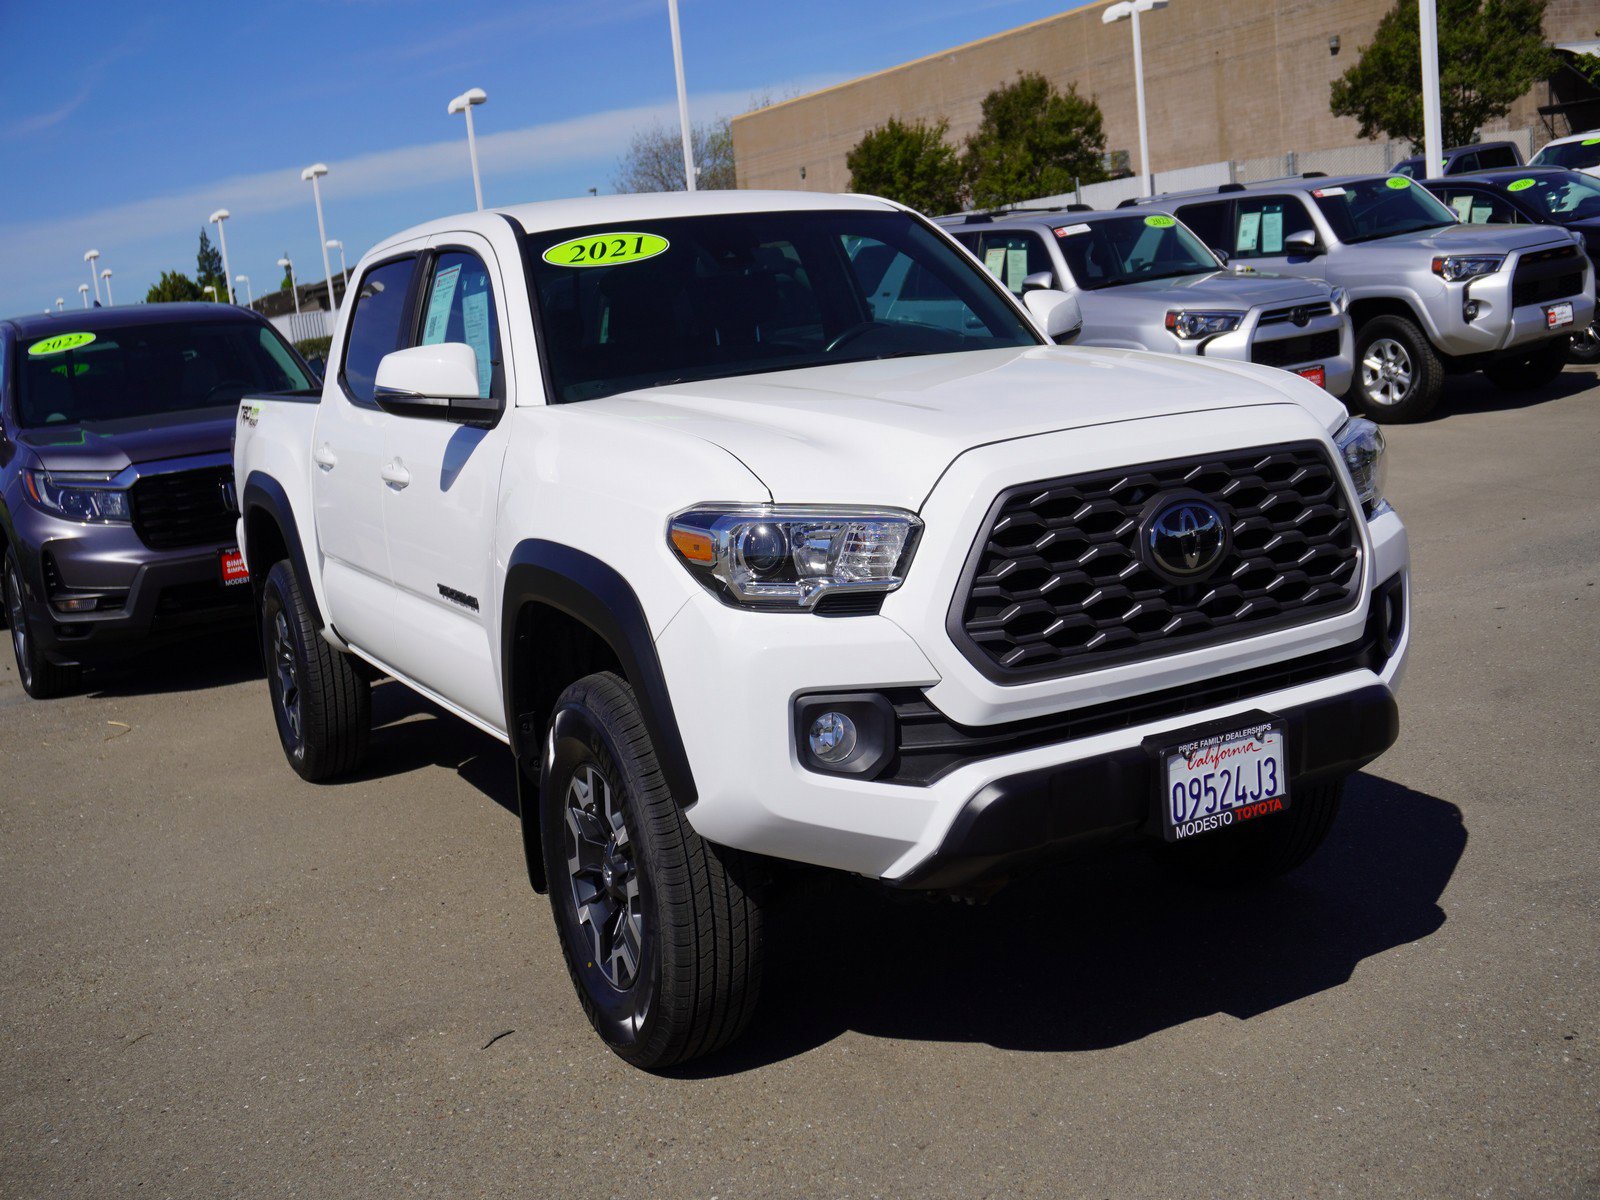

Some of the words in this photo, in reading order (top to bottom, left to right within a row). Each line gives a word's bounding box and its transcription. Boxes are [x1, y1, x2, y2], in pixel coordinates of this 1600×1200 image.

[569, 236, 644, 263] 2021
[41, 334, 83, 353] 2022
[226, 558, 243, 568] SIMP
[227, 565, 247, 574] SIMPL
[225, 576, 250, 586] MODEST
[1178, 741, 1199, 753] PRICE
[1200, 735, 1224, 748] FAMILY
[1225, 723, 1272, 742] DEALERSHIPS
[1187, 741, 1262, 771] California
[1172, 757, 1277, 823] 09524J3
[1176, 811, 1233, 839] MODESTO
[1235, 798, 1283, 821] TOYOTA
